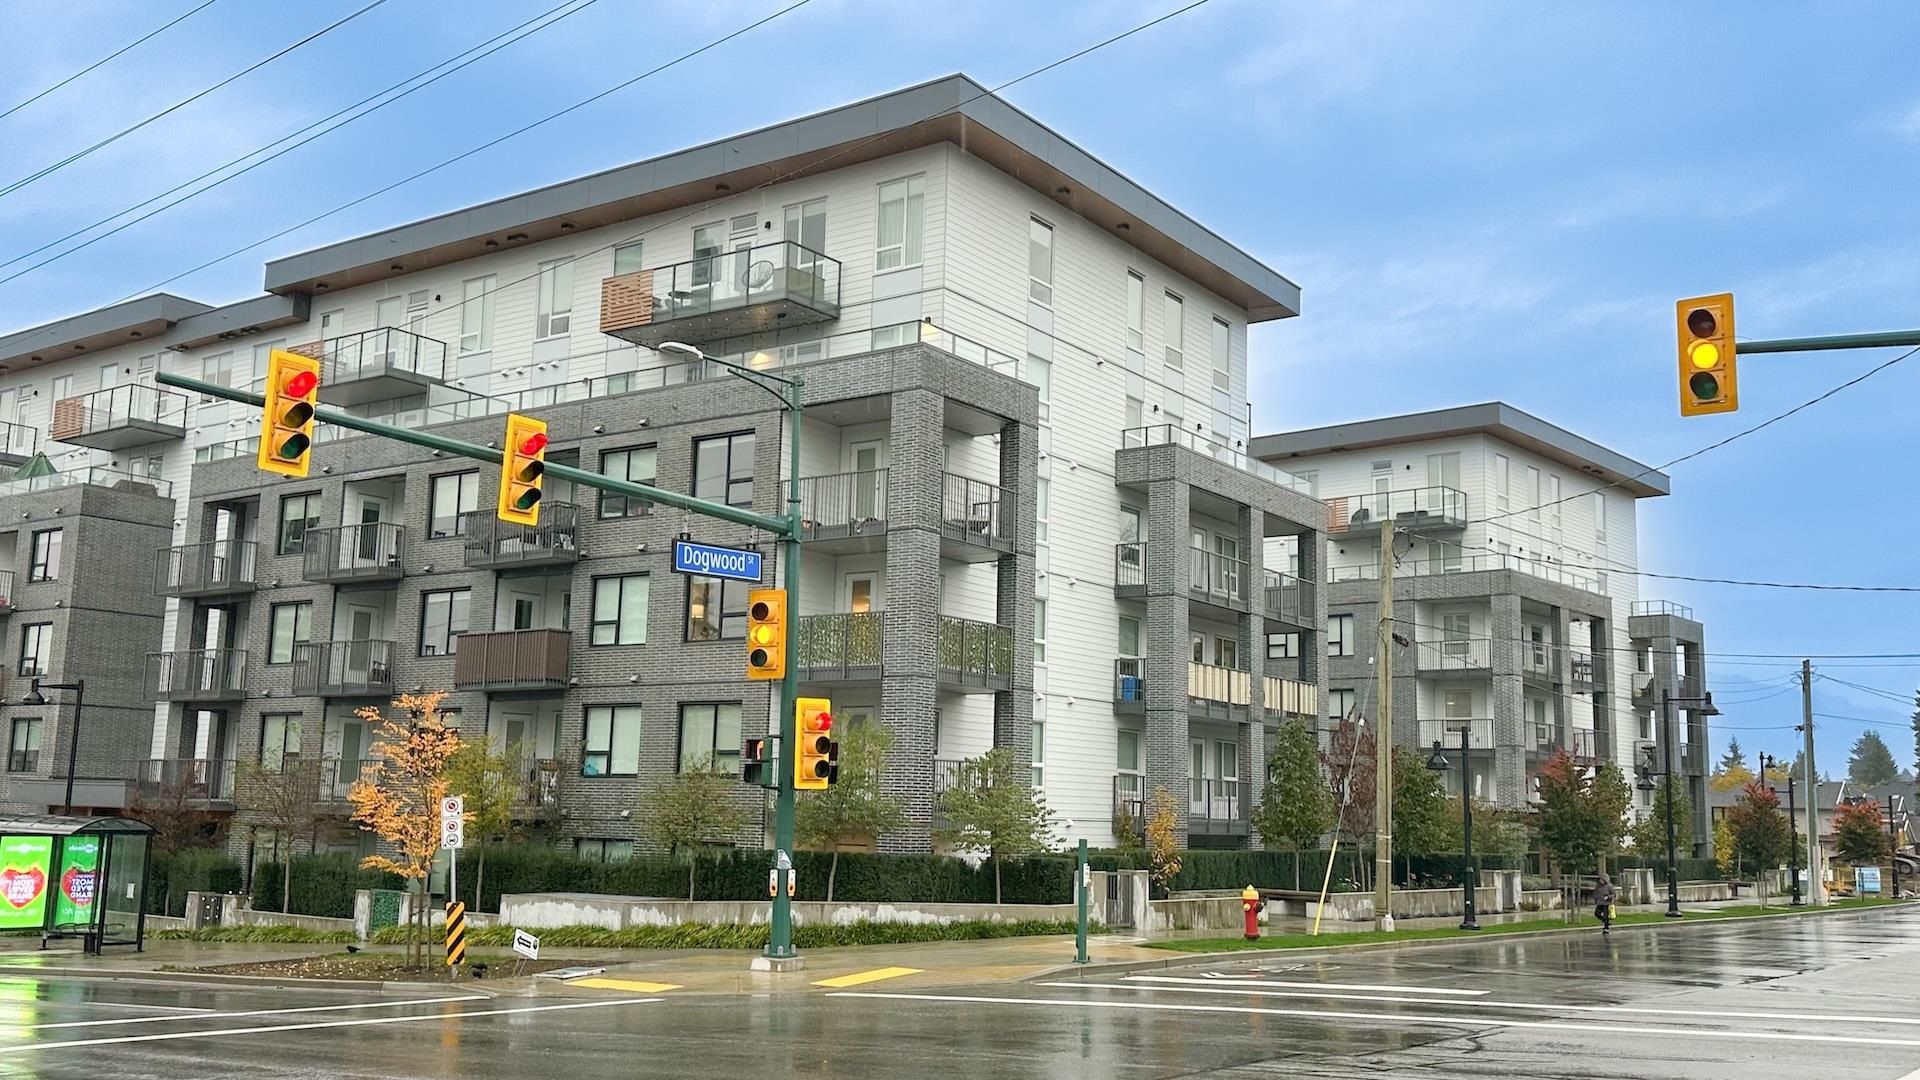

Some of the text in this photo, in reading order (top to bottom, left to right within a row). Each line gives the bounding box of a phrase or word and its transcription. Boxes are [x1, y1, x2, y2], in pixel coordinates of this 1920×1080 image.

[684, 546, 754, 572] Dogwood St
[13, 879, 35, 887] MOST
